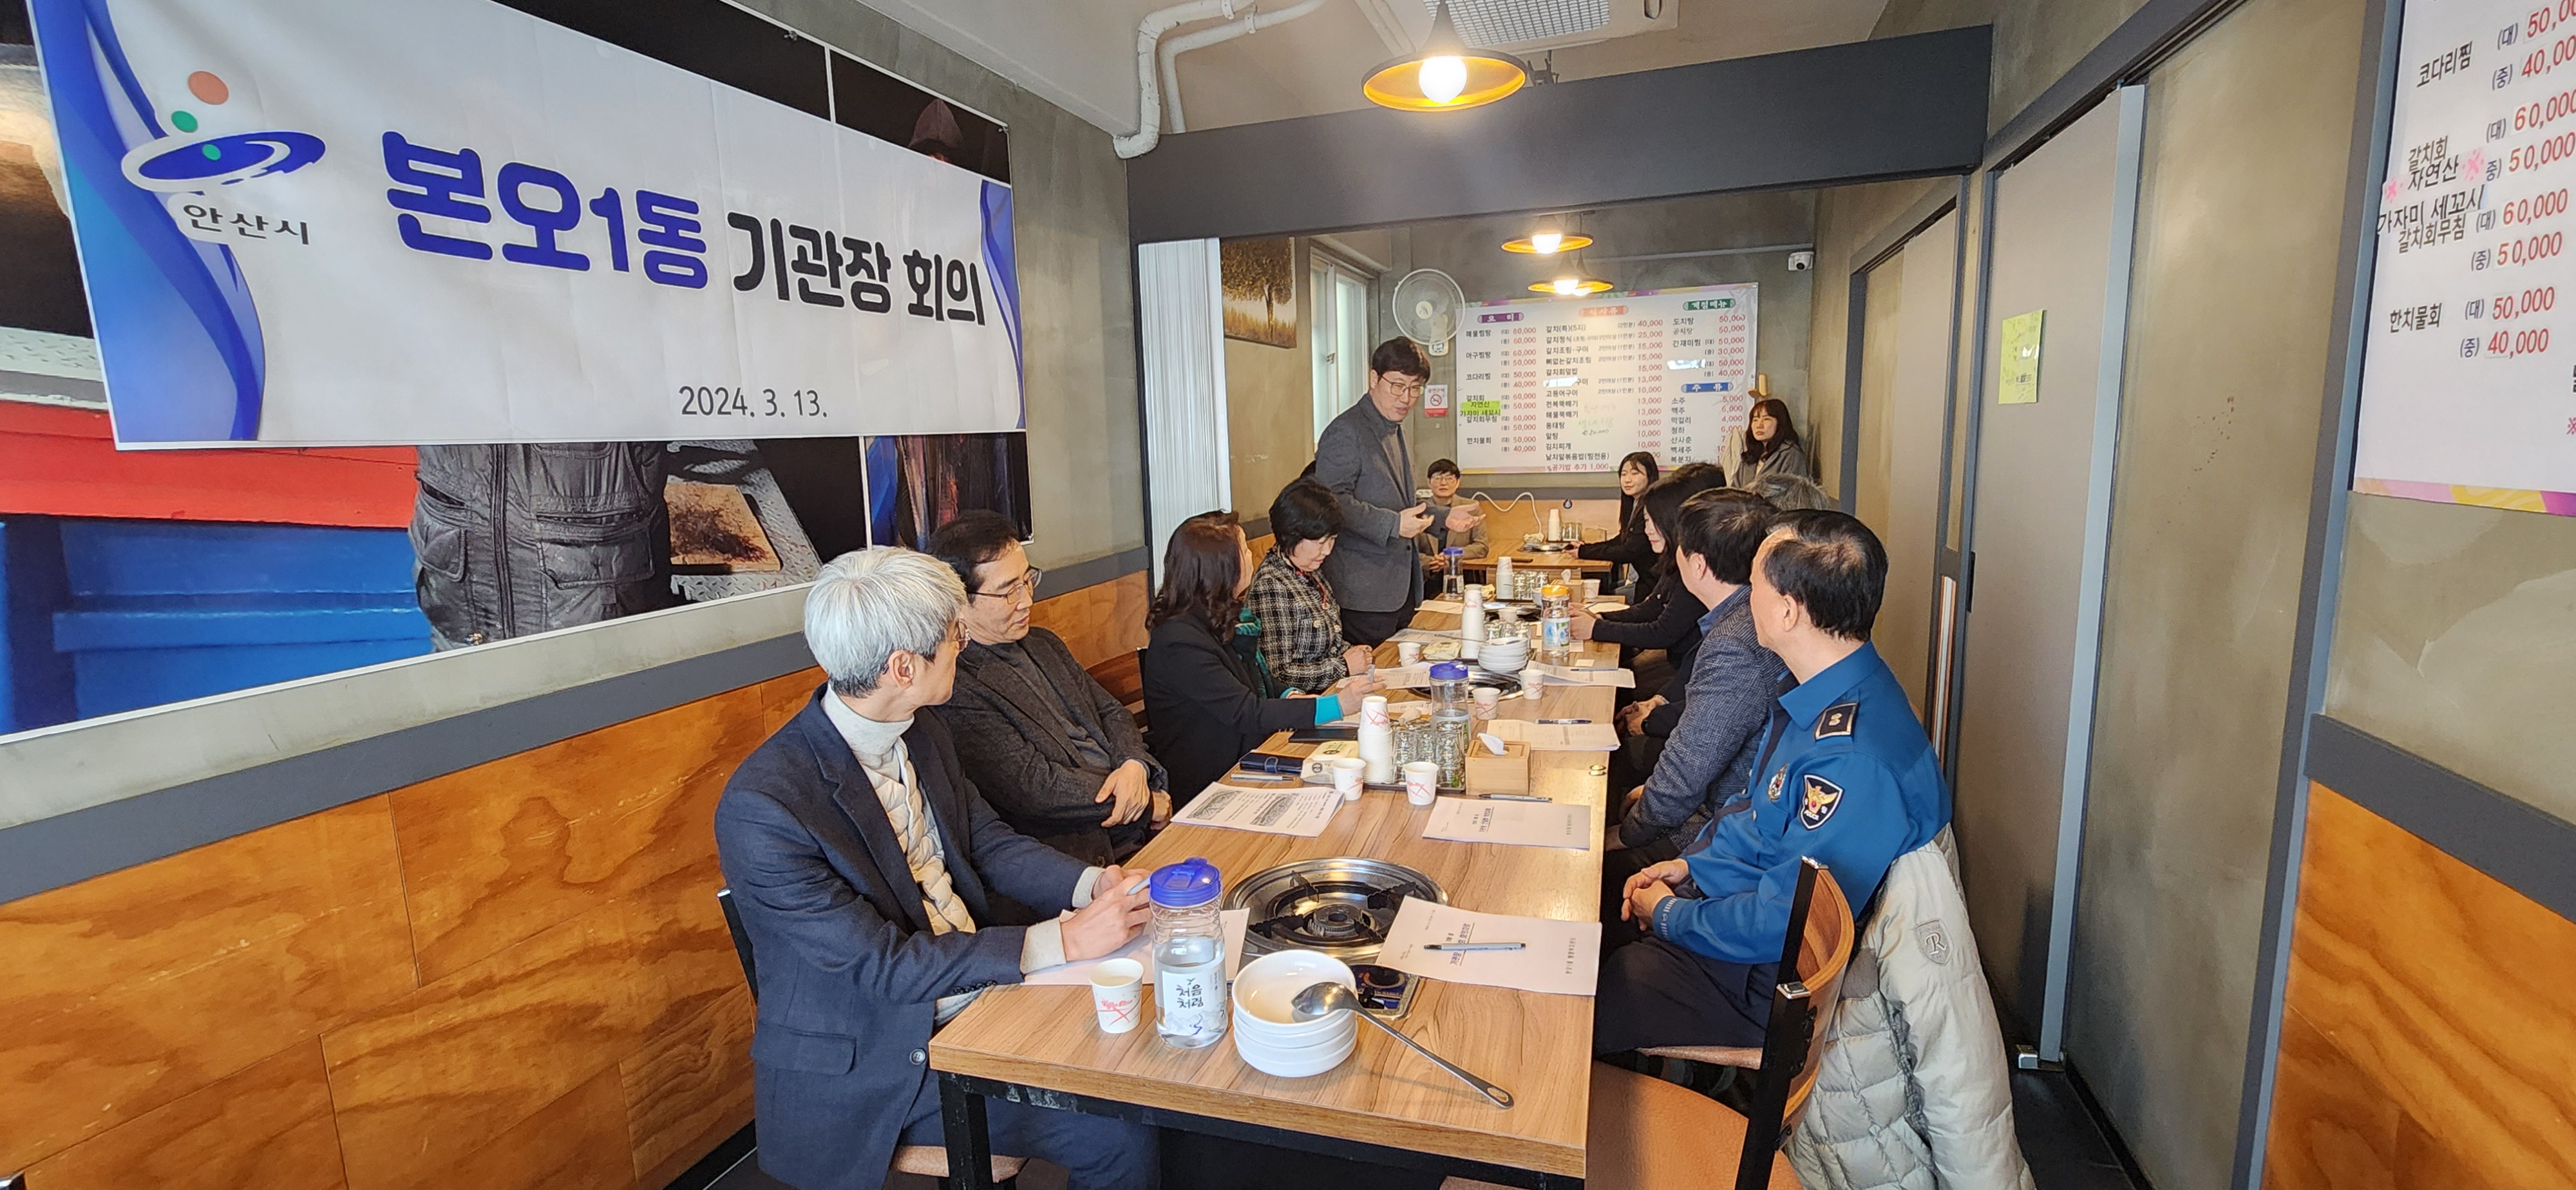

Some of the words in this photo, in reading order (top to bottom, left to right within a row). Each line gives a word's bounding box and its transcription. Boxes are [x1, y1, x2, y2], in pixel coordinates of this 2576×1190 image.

[2416, 41, 2473, 88] 코다리찜
[2497, 23, 2518, 50] (대)
[2492, 64, 2512, 90] (중)
[2408, 135, 2448, 172] 갈치회
[2486, 118, 2506, 143] (대)
[2486, 158, 2502, 182] 중)
[2509, 131, 2576, 172] 50,000
[2408, 154, 2459, 191] 자연산
[2378, 200, 2424, 233] 가자미
[2430, 184, 2485, 220] 세꼬시
[2398, 212, 2467, 254] 갈치회무침
[2476, 209, 2496, 232] (대)
[2503, 188, 2568, 225] 60,000
[184, 204, 309, 245] 안산시
[383, 131, 708, 289] 본오1동
[727, 212, 891, 313] 기관장
[903, 249, 986, 326] 회의
[2471, 249, 2490, 271] (중)
[2497, 231, 2562, 267] 50,000
[1638, 319, 1663, 328] 40,000
[1719, 314, 1745, 323] 50,000
[2389, 302, 2442, 333] 한치물회
[2465, 298, 2485, 320] (대)
[2492, 287, 2555, 320] 50,000
[1546, 335, 1572, 344] 갈치정식
[1638, 330, 1663, 339] 25,000
[1672, 339, 1701, 347] 간재미찜
[1719, 337, 1745, 345] 50,000
[1719, 325, 1745, 333] 50,000
[2459, 337, 2479, 358] (중)
[2487, 328, 2549, 359] 40,000
[1719, 359, 1744, 367] 50,000
[679, 385, 755, 417] 2024.
[762, 388, 786, 417] 3.
[793, 389, 828, 417] 13.
[1723, 395, 1743, 403] 5,000
[1925, 932, 1947, 956] R
[1176, 984, 1203, 997] 처음
[1177, 997, 1204, 1009] 처럼
